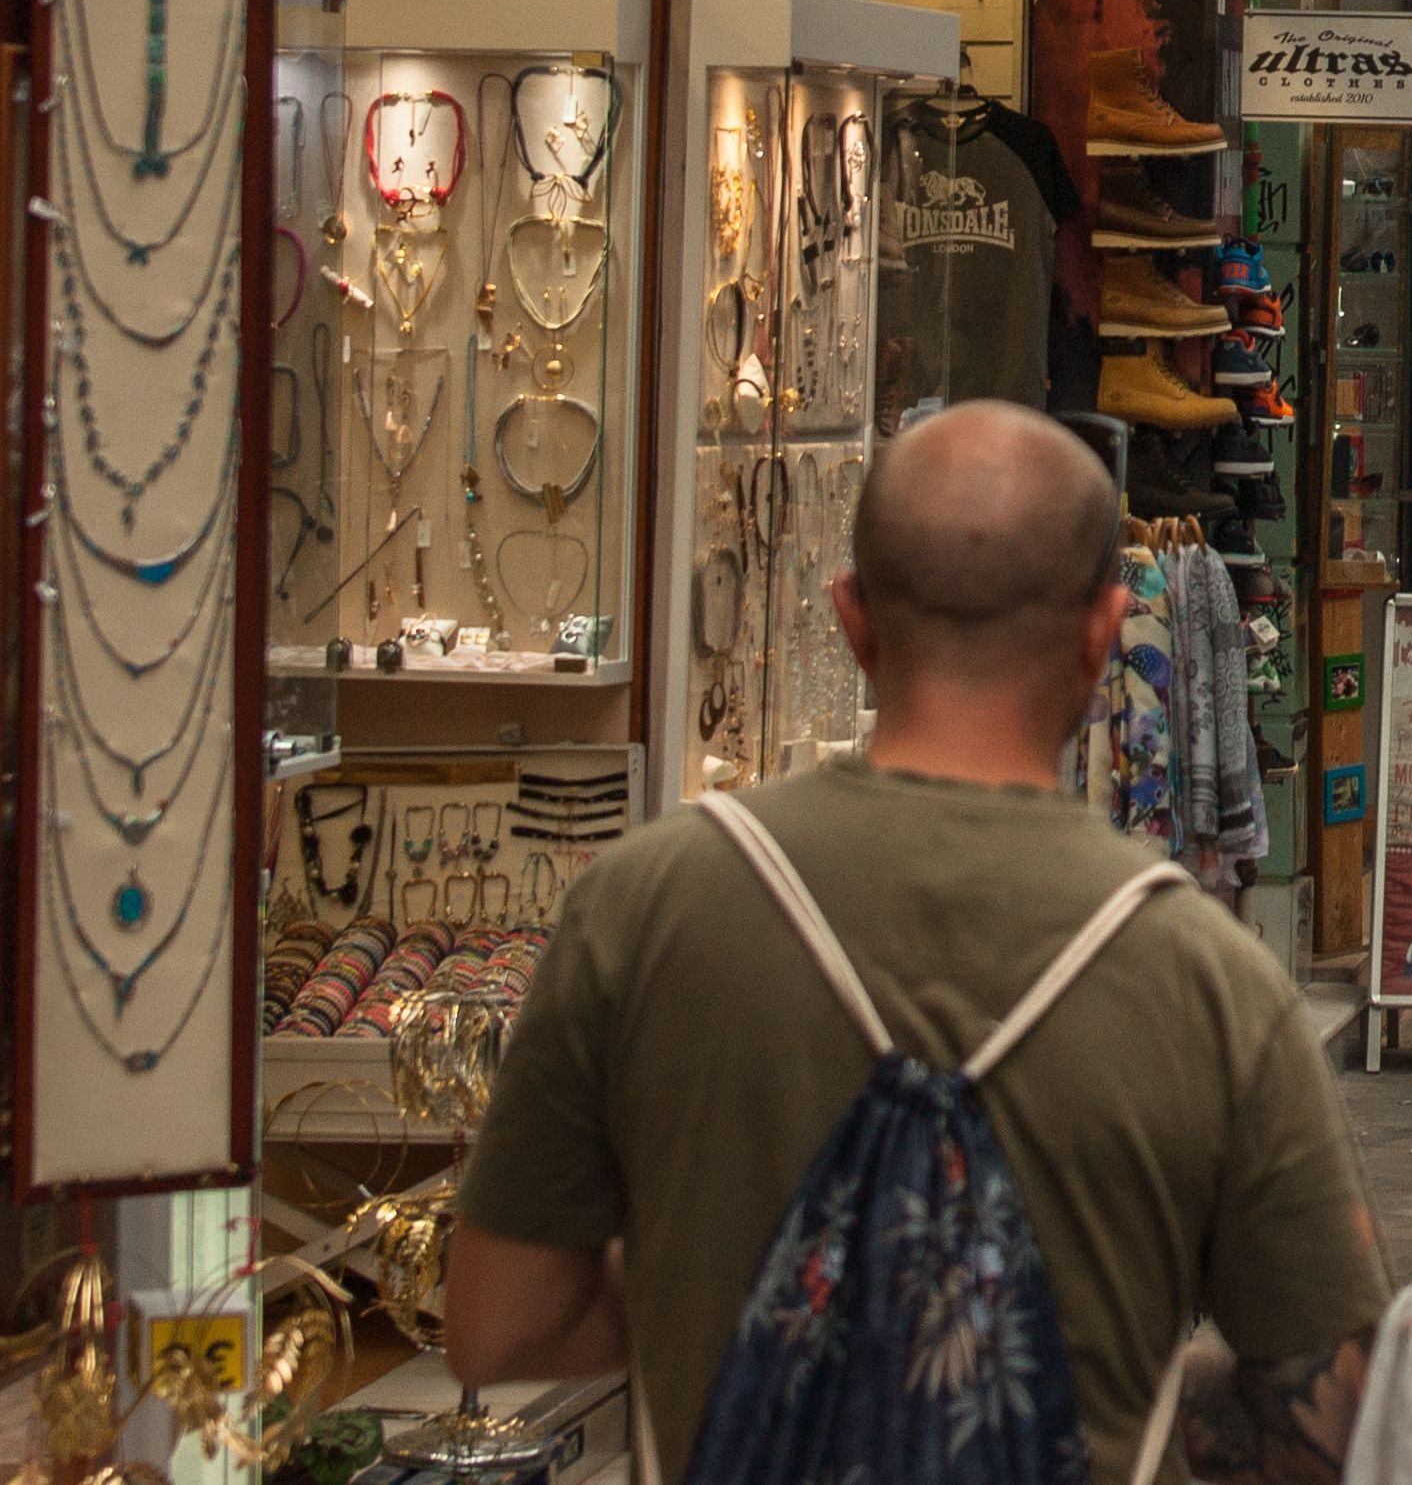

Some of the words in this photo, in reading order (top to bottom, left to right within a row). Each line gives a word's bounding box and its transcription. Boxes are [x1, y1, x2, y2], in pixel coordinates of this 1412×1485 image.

[1273, 31, 1307, 44] The
[1318, 29, 1394, 48] Original
[1259, 77, 1405, 89] CLOTHES
[1290, 92, 1343, 103] established
[1345, 92, 1374, 104] 2010
[895, 199, 1015, 250] LONSDALE
[933, 243, 975, 254] LONDON
